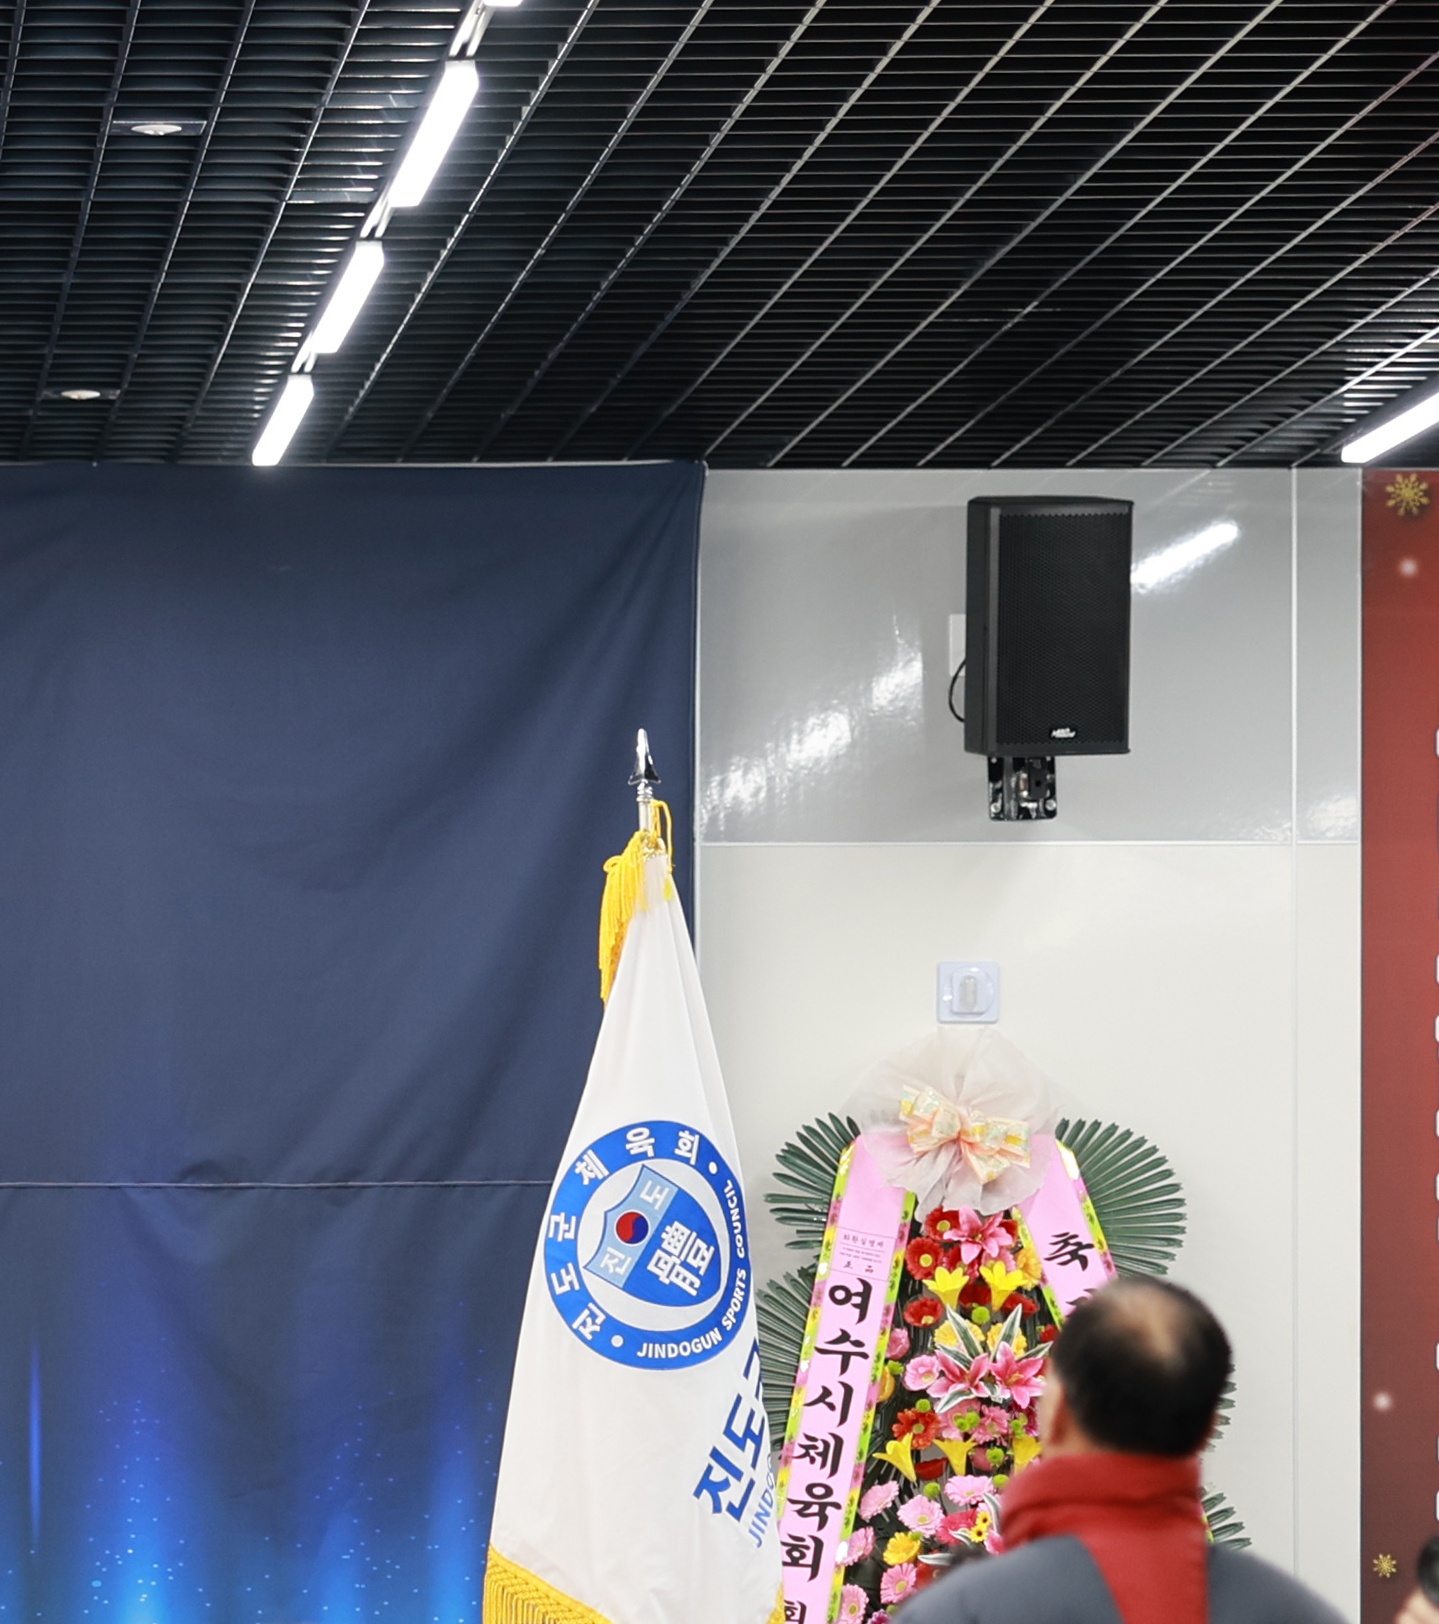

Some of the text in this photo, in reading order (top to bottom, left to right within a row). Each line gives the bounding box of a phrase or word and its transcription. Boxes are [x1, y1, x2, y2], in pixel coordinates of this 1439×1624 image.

[549, 1127, 700, 1341] 진도군체육회
[600, 1179, 670, 1275] 진 도
[636, 1179, 747, 1359] JINDOGUN SPORTS COUNCIL
[780, 1277, 874, 1583] 여수시체육회
